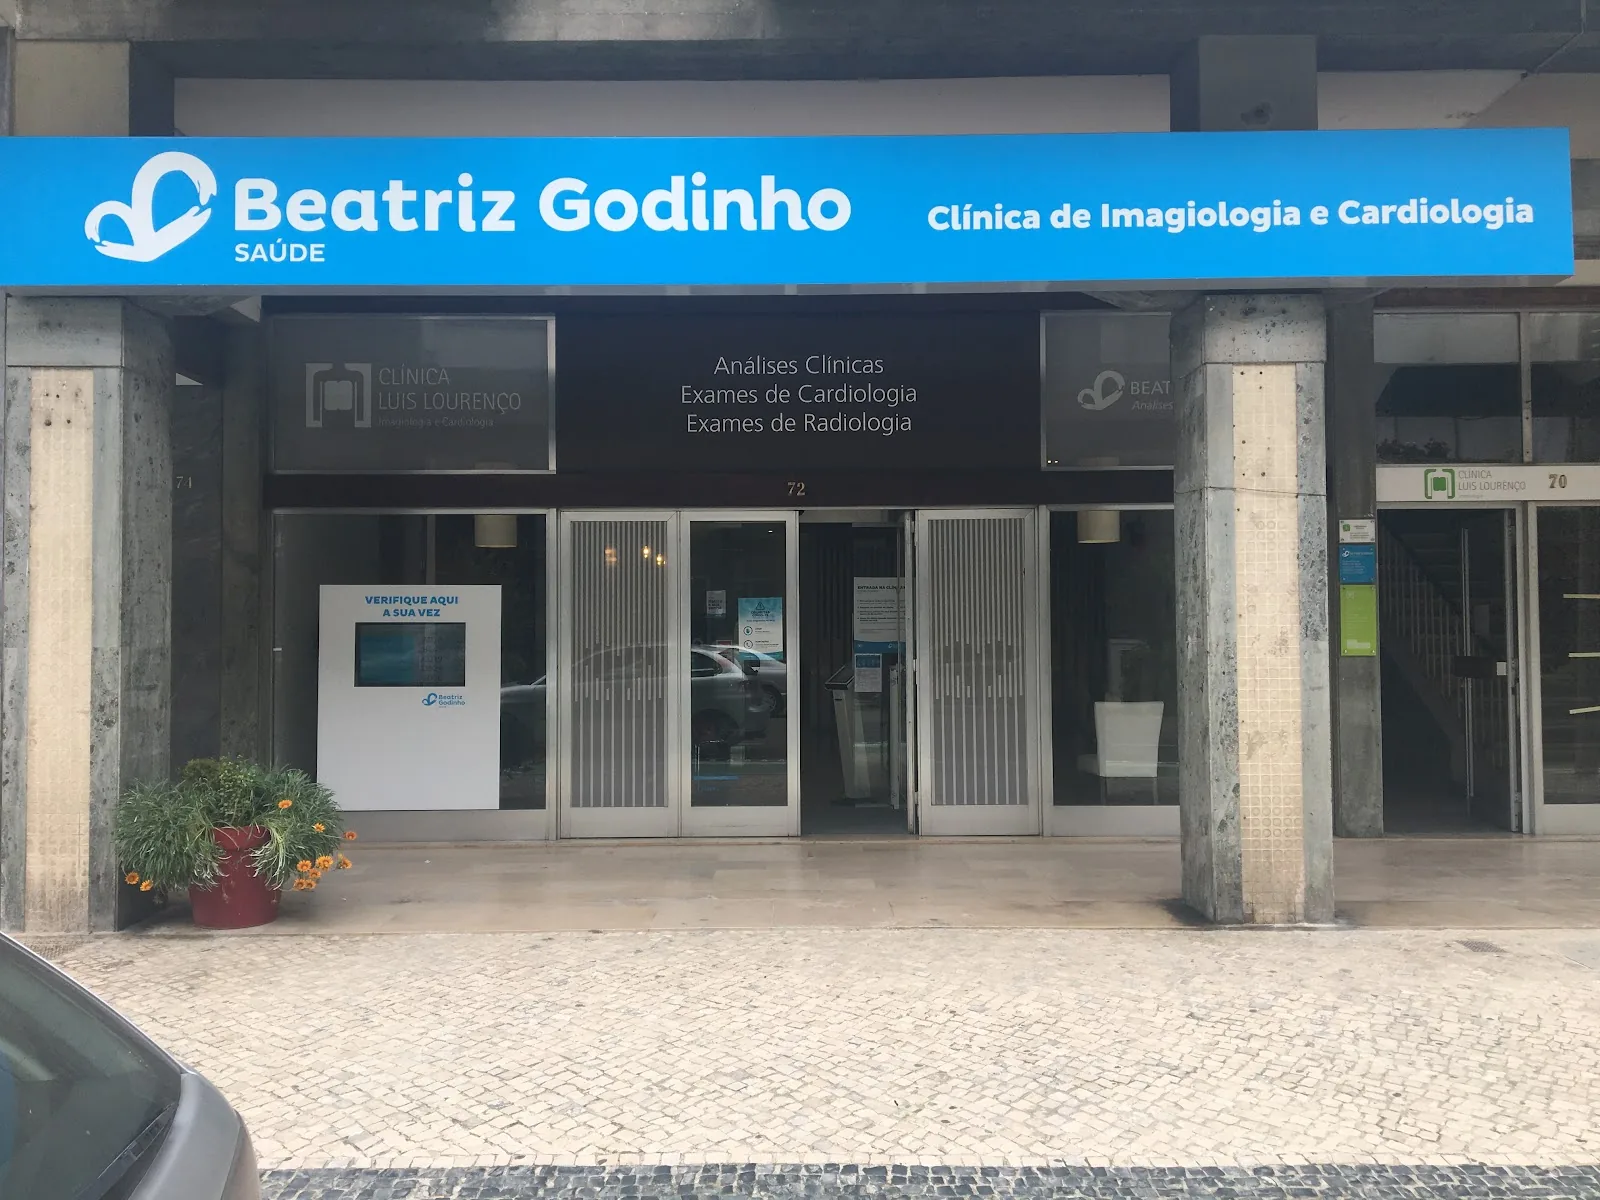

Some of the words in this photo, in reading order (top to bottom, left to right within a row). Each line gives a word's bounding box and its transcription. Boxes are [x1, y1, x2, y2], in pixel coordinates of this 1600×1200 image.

[234, 172, 516, 233] Beatriz
[538, 171, 852, 232] Godinho
[927, 203, 1041, 232] Clínica
[1049, 203, 1092, 229] de
[1101, 200, 1301, 233] Imagiologia
[1310, 207, 1330, 227] e
[1338, 197, 1535, 230] Cardiologia
[234, 237, 326, 263] SAÚDE
[378, 363, 450, 385] CLÍNICA
[713, 355, 798, 375] Análises
[805, 354, 884, 375] Clínicas
[680, 385, 758, 404] Exames
[765, 384, 791, 403] de
[798, 383, 918, 407] Cardiologia
[1130, 380, 1171, 395] BEAT
[378, 392, 417, 410] LUIS
[424, 392, 522, 414] LOURENÇO
[686, 413, 764, 433] Exames
[771, 412, 797, 432] de
[804, 411, 913, 436] Radiologia
[1458, 469, 1493, 480] CLÍNICA
[1548, 473, 1569, 489] 70
[787, 481, 806, 497] 72
[1458, 481, 1477, 492] LUIS
[1479, 480, 1527, 493] LOURENÇO
[365, 595, 428, 606] VERIFIQUE
[429, 595, 459, 606] AQUI
[382, 608, 391, 617] A
[392, 608, 416, 617] SUA
[418, 608, 441, 617] VEZ
